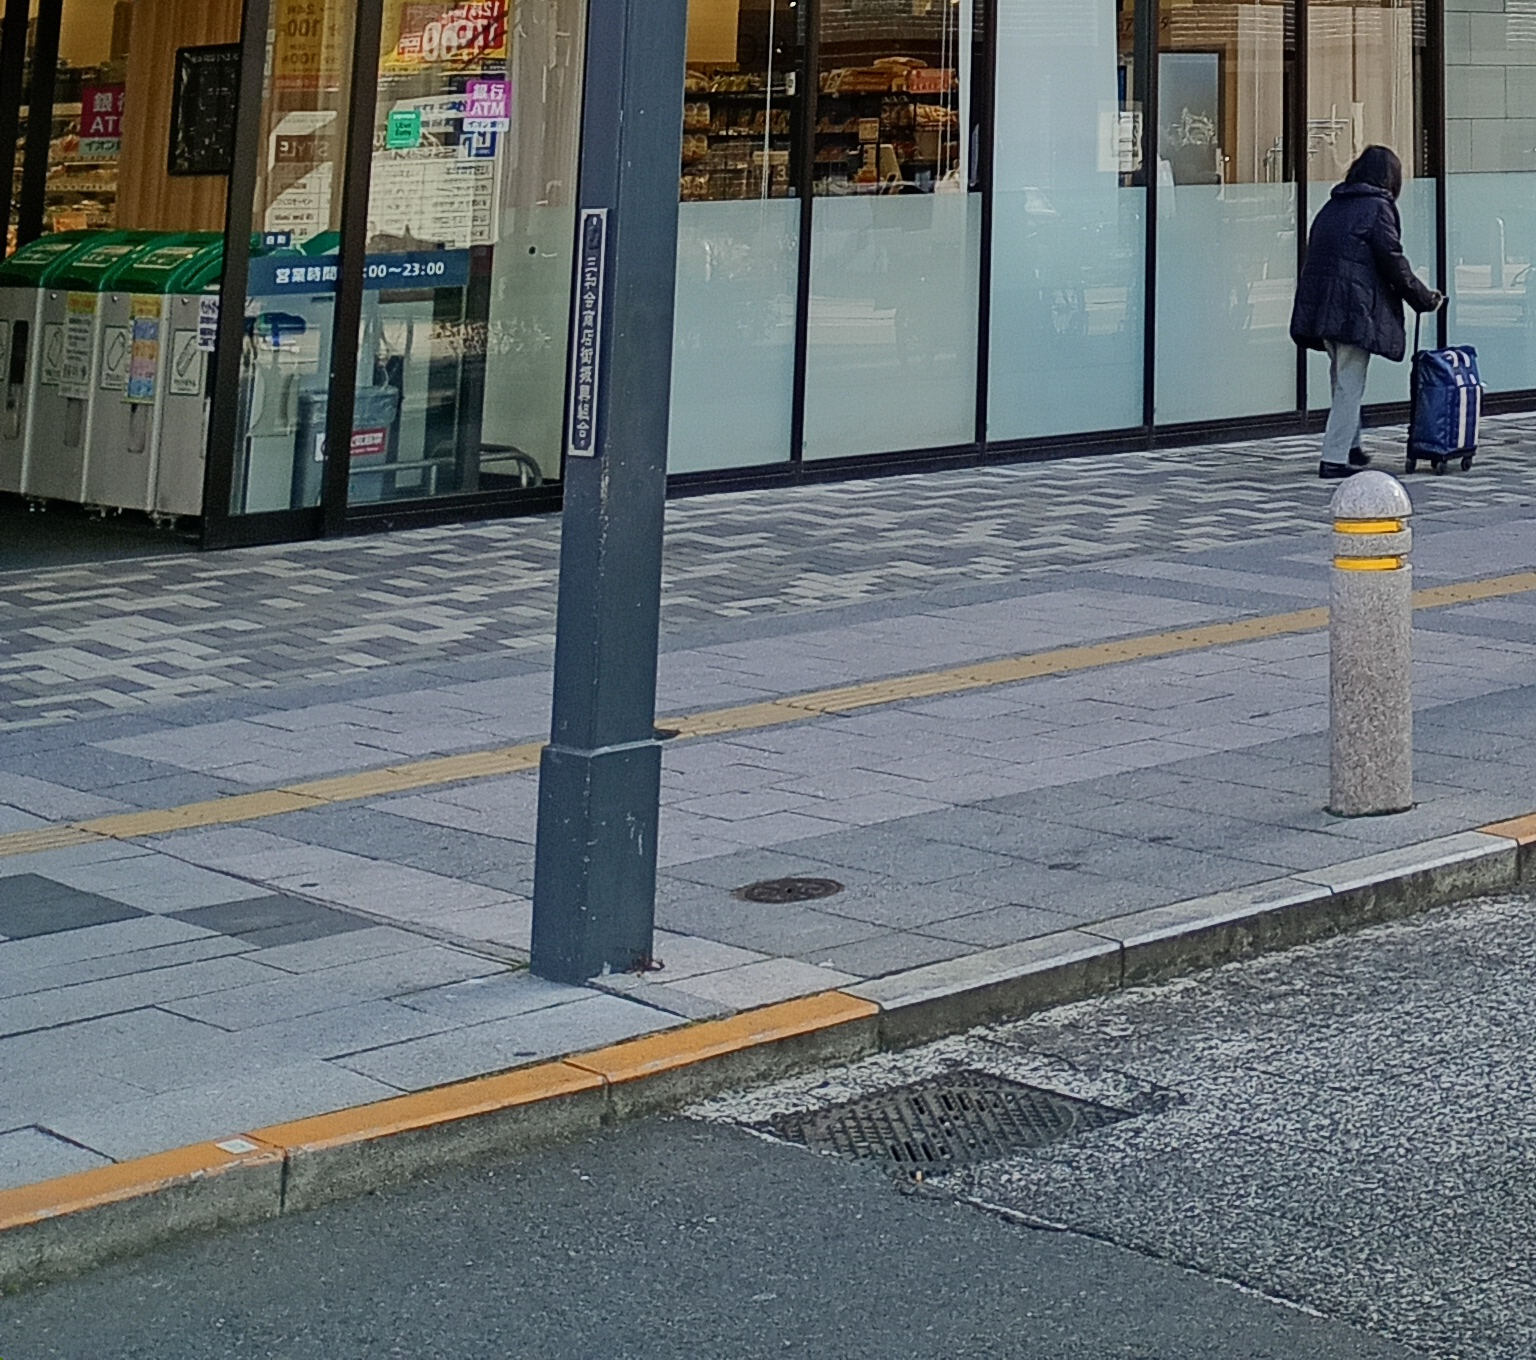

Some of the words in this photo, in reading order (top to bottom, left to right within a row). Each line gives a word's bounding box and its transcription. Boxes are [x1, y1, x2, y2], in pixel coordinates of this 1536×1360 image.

[472, 82, 505, 101] 銀行
[471, 100, 506, 117] ATM
[89, 115, 124, 134] AT
[275, 265, 338, 285] 営業時間
